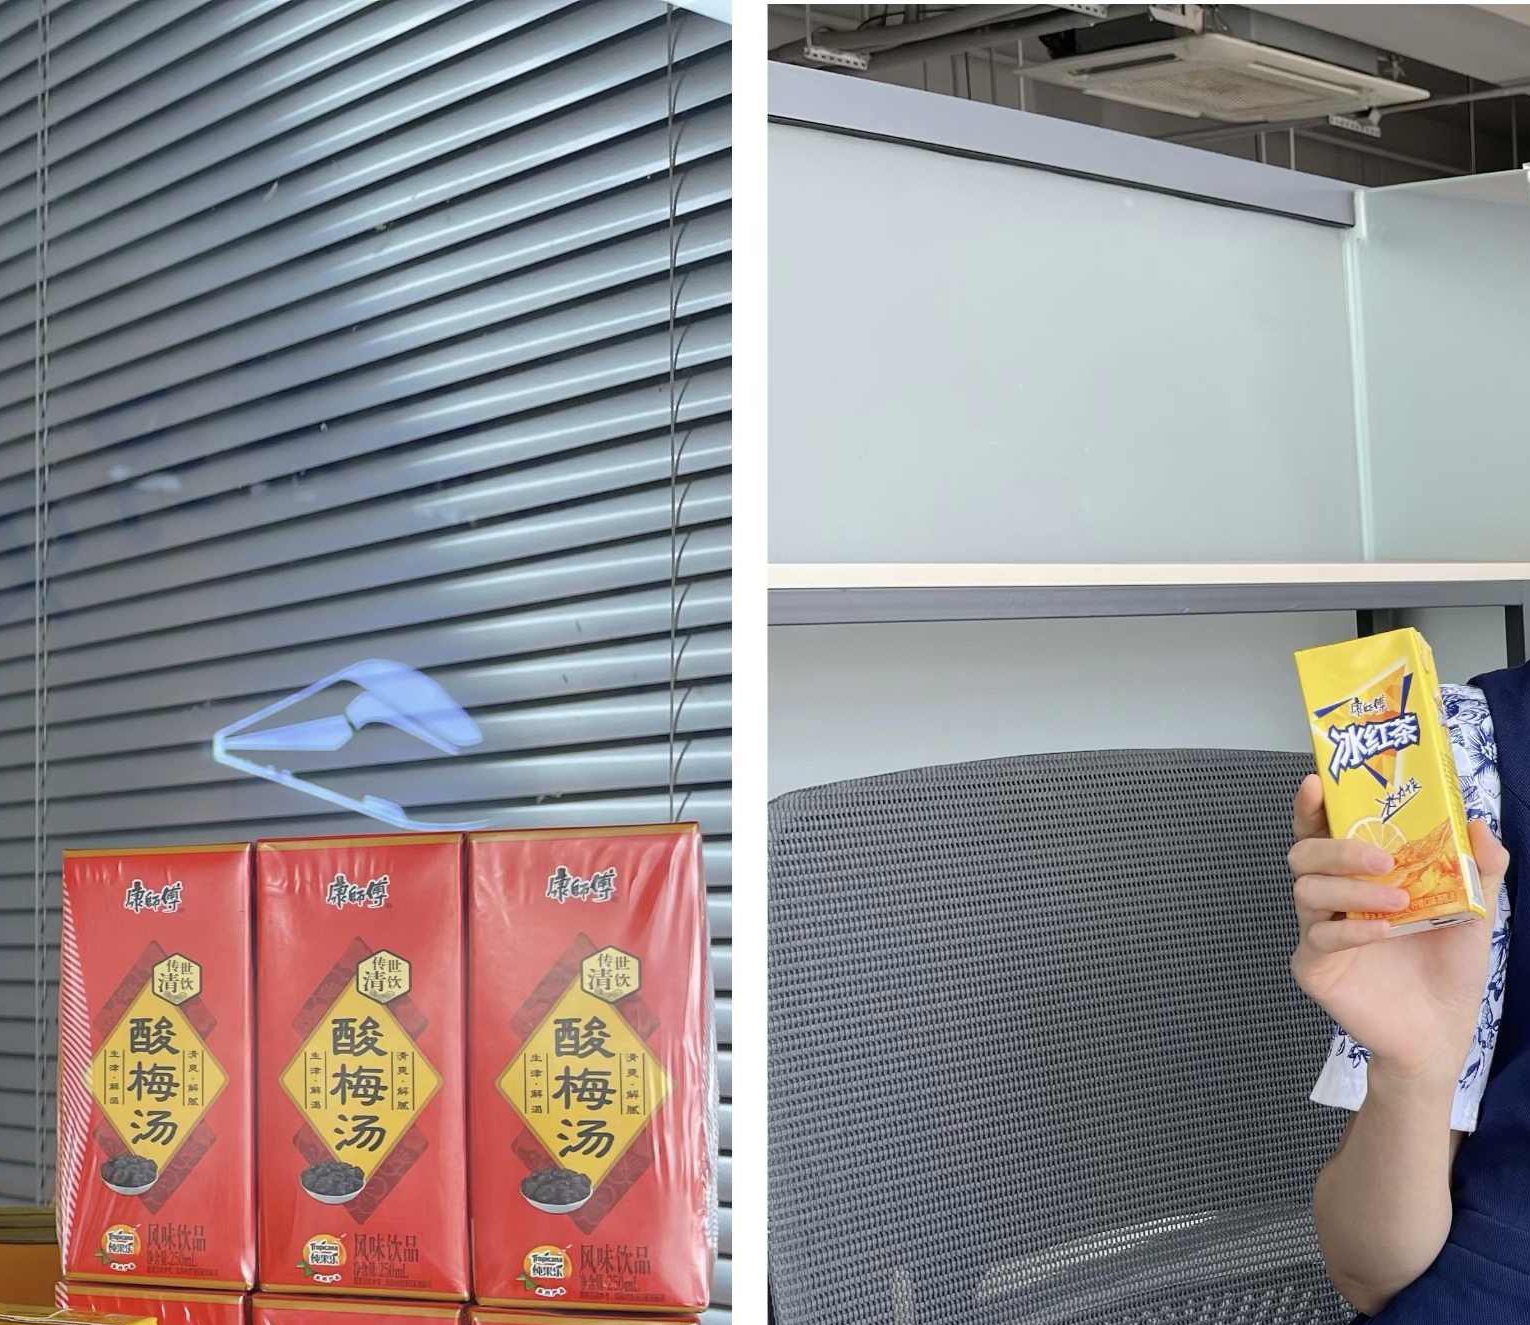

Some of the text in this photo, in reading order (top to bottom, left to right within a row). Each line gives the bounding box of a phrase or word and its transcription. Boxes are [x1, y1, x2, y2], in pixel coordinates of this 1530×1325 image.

[1330, 716, 1418, 780] 冰红茶
[126, 1015, 181, 1147] 酸梅汤
[329, 1015, 389, 1153] 酸梅汤
[552, 1014, 618, 1160] 酸梅汤
[147, 1222, 206, 1251] 风味饮品
[353, 1232, 419, 1263] 风味饮品
[532, 1254, 563, 1264] Tropicana
[579, 1243, 651, 1275] 风味饮品
